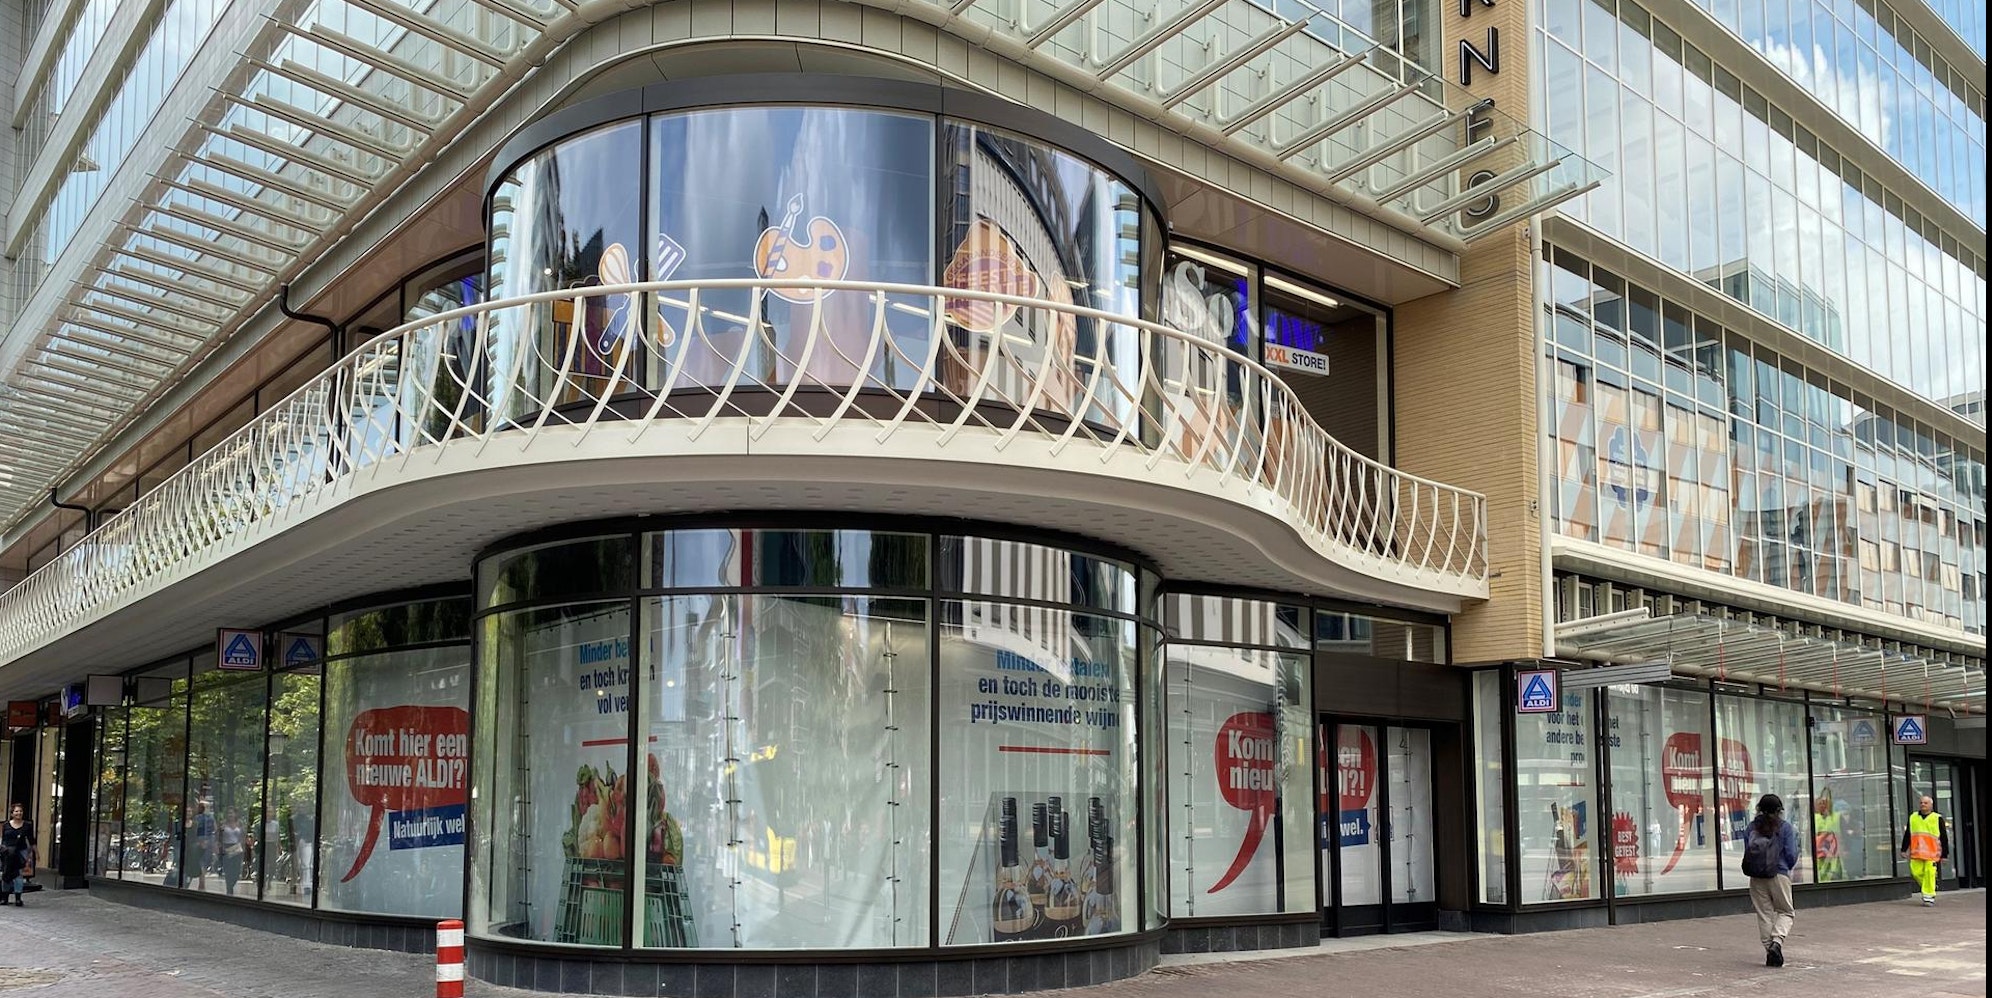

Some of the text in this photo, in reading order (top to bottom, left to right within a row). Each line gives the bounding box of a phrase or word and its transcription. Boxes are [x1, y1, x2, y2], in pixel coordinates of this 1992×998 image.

[1459, 0, 1500, 216] NES
[1266, 346, 1326, 371] XXL STORE!
[227, 657, 254, 665] ALDI
[580, 642, 613, 665] Minder
[580, 673, 591, 690] en
[594, 665, 615, 689] toch
[978, 677, 998, 695] en
[1002, 675, 1037, 697] toch
[1042, 679, 1061, 699] de
[597, 693, 612, 715] vol
[971, 701, 1081, 726] prijswinnende
[1526, 699, 1550, 707] ALDI
[1566, 710, 1580, 726] het
[355, 727, 467, 757] Komt hier een
[1546, 729, 1574, 744] andere
[1669, 746, 1700, 772] Komt
[356, 757, 412, 788] nieuwe
[393, 816, 443, 840] Natuurlijk
[1617, 830, 1632, 843] BEST
[1614, 844, 1636, 858] GETEST
